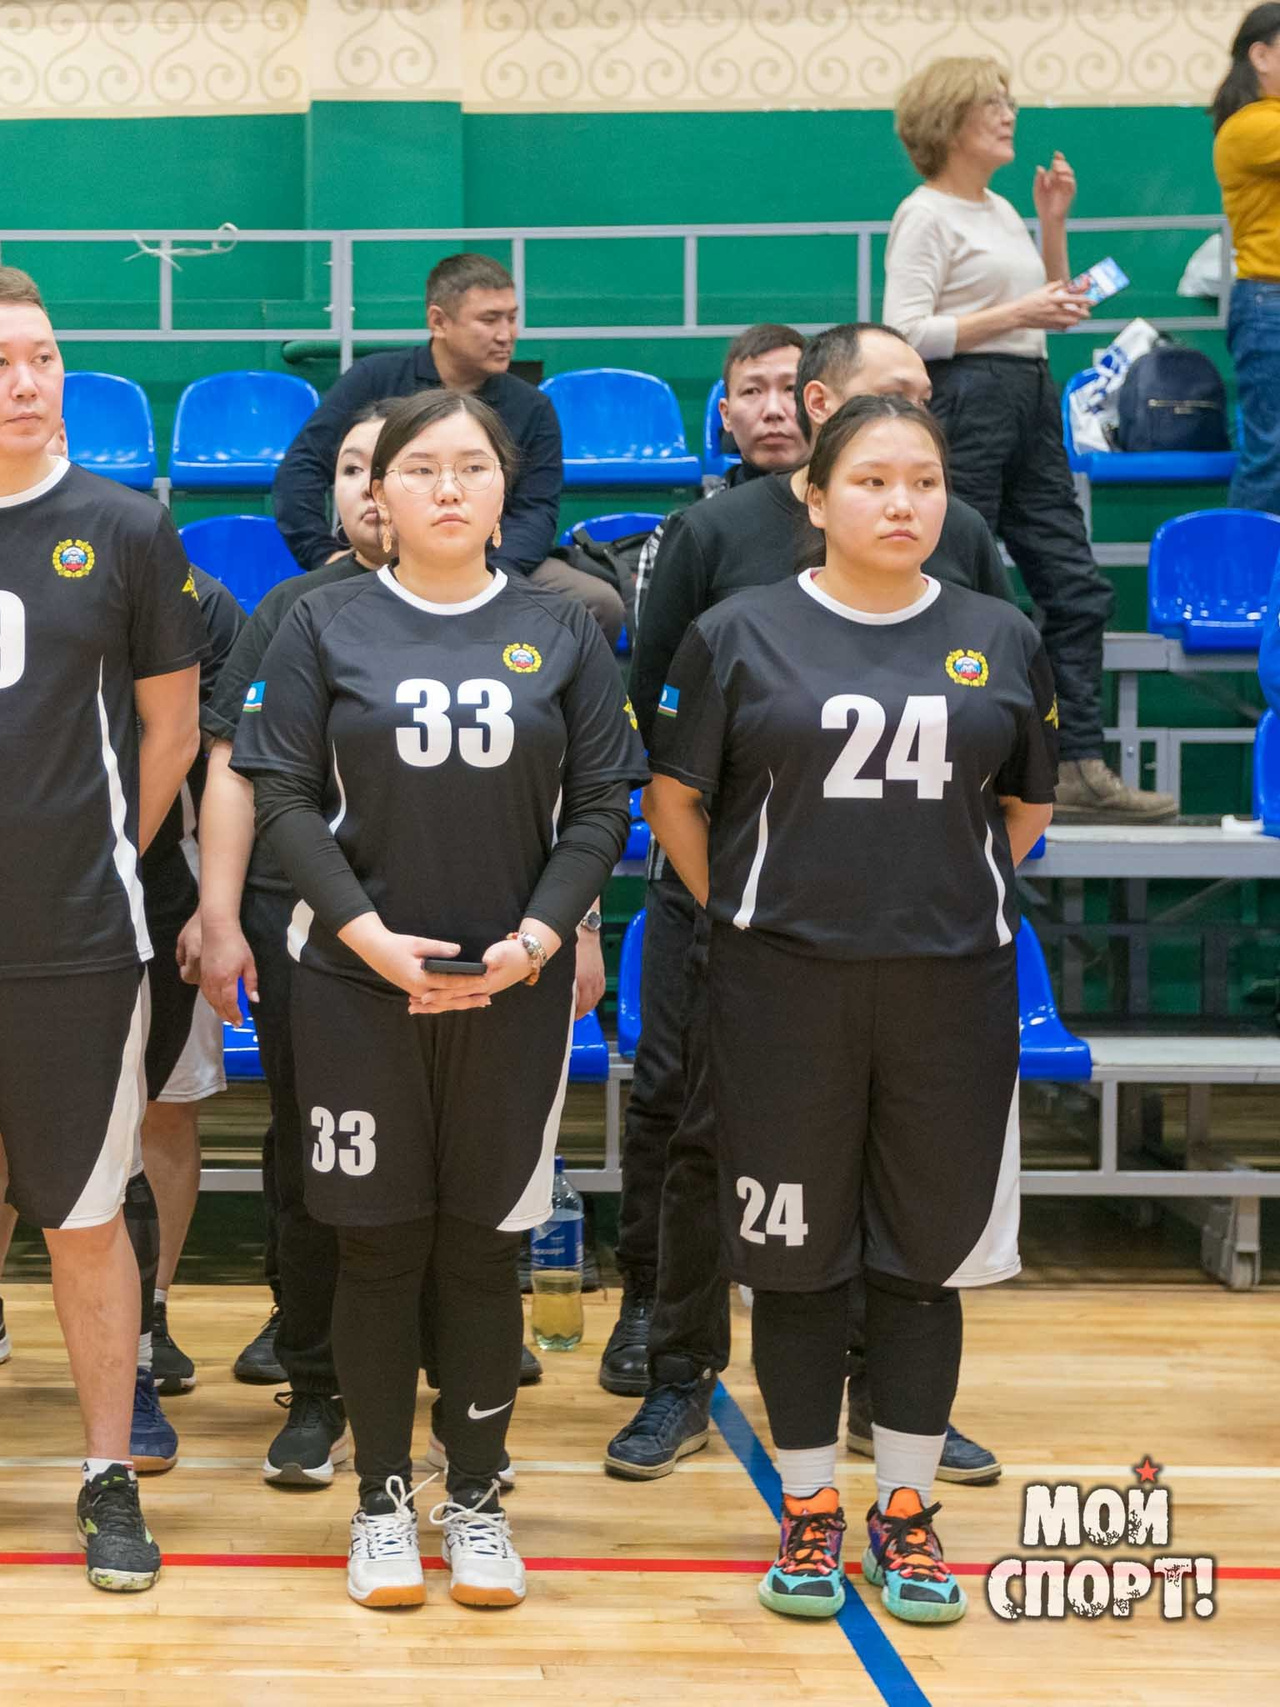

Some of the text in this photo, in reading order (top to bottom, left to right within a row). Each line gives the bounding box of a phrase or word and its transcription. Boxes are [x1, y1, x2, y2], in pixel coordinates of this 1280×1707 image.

[395, 677, 515, 769] 33
[820, 693, 953, 800] 24
[310, 1105, 377, 1177] 33
[735, 1175, 809, 1247] 24
